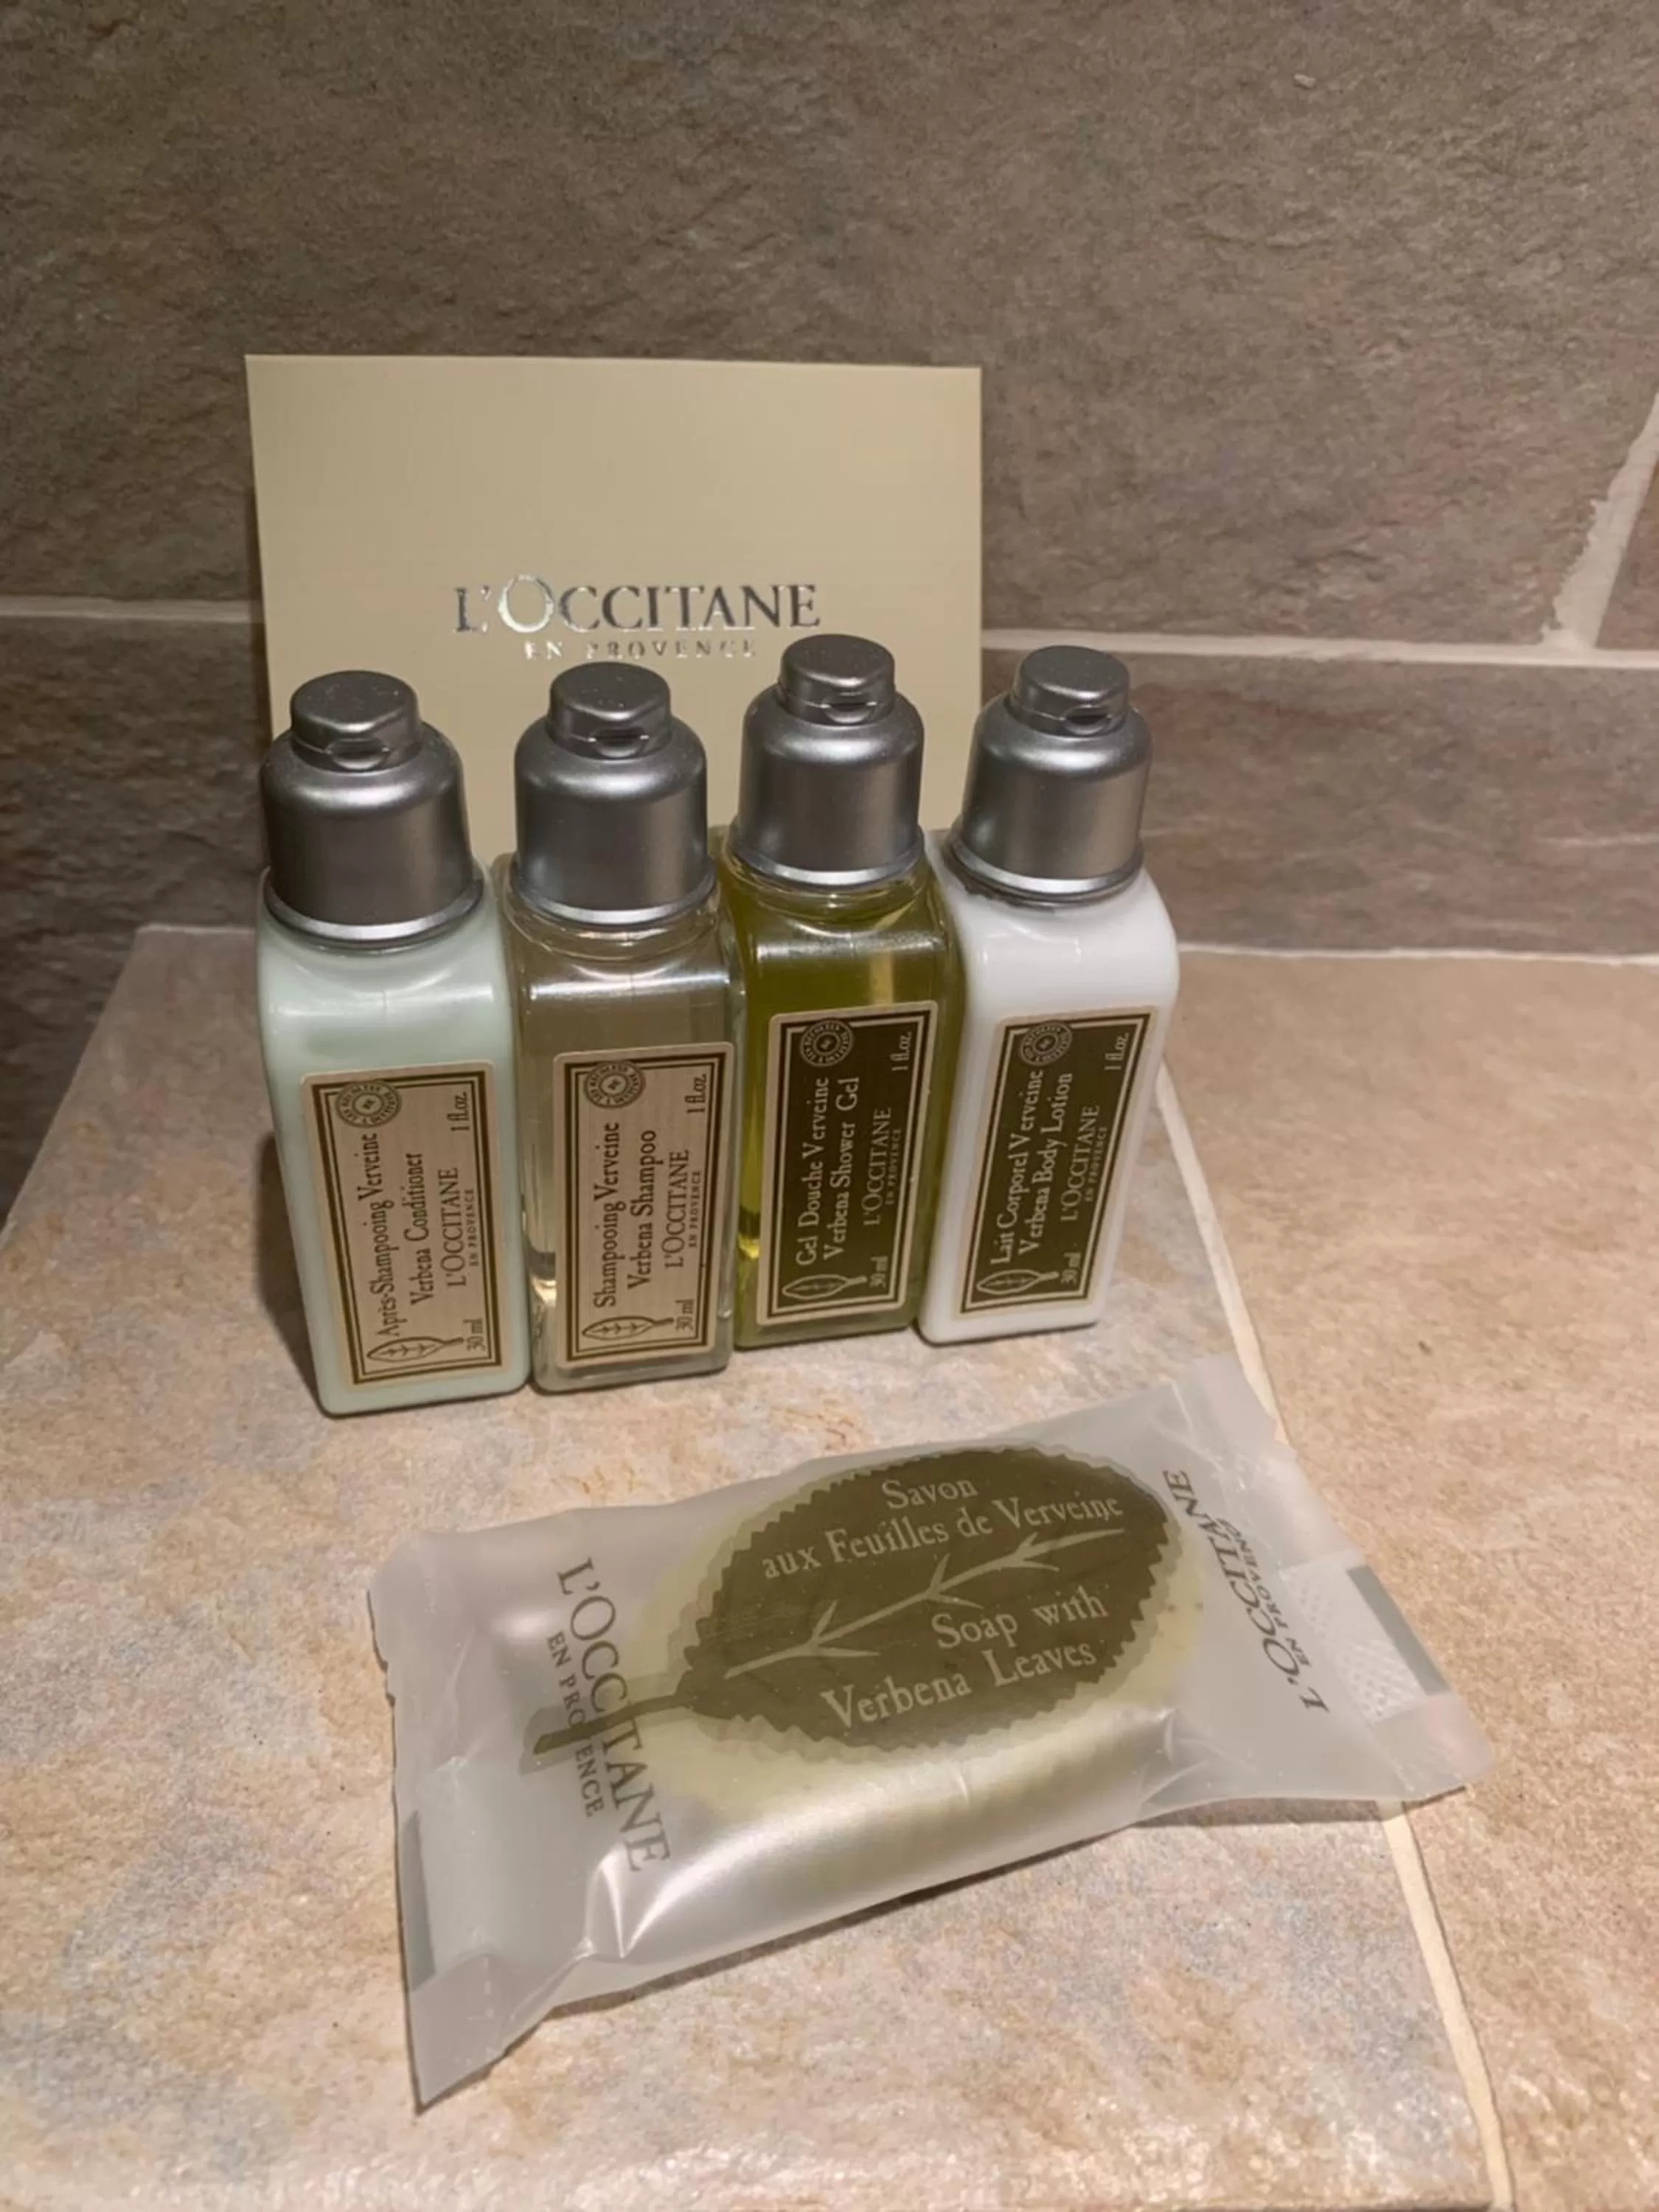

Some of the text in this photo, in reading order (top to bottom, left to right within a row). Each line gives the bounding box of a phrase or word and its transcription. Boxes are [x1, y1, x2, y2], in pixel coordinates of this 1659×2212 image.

[453, 574, 821, 634] L'OCCITANE
[524, 640, 755, 659] EN PROVENCE
[802, 1077, 829, 1159] Verveine
[1040, 1073, 1073, 1133] Lotion
[354, 1133, 383, 1202] Verveine
[594, 1121, 619, 1201] Verveine
[824, 1077, 860, 1260] Verbena Shower Gel
[861, 1108, 891, 1226] L'OCCITANE
[888, 1129, 902, 1185] PROVENCE
[991, 1070, 1043, 1265] Lait Corporel Verveine
[1033, 1138, 1068, 1183] Body
[1061, 1105, 1099, 1222] L'OCCITANE
[401, 1153, 433, 1306] Verbena Conditioner
[438, 1167, 466, 1287] L'OCCITANE
[465, 1189, 479, 1251] PROVENCE
[627, 1130, 664, 1290] Verbena Shampoo
[661, 1150, 689, 1269] L'OCCITANE
[689, 1170, 702, 1228] PROVENCE
[799, 1164, 823, 1226] Douche
[1018, 1186, 1051, 1255] Verbena
[594, 1201, 626, 1308] Shampooing
[796, 1235, 817, 1266] Gel
[869, 1256, 888, 1289] 30 ml
[1061, 1251, 1080, 1285] 30 ml
[464, 1318, 486, 1352] 30 ml
[675, 1298, 694, 1332] 30 ml
[882, 1478, 978, 1510] Savon
[762, 1491, 1123, 1579] aux Feuilles de Verveine
[931, 1585, 1108, 1649] Soap with
[1163, 1470, 1330, 1713] L'OCCITANE
[820, 1641, 1096, 1728] Verbena Leaves
[1286, 1637, 1312, 1666] EN
[547, 1631, 605, 1818] EN PROENCE
[557, 1557, 670, 1872] L'OCCTANE
